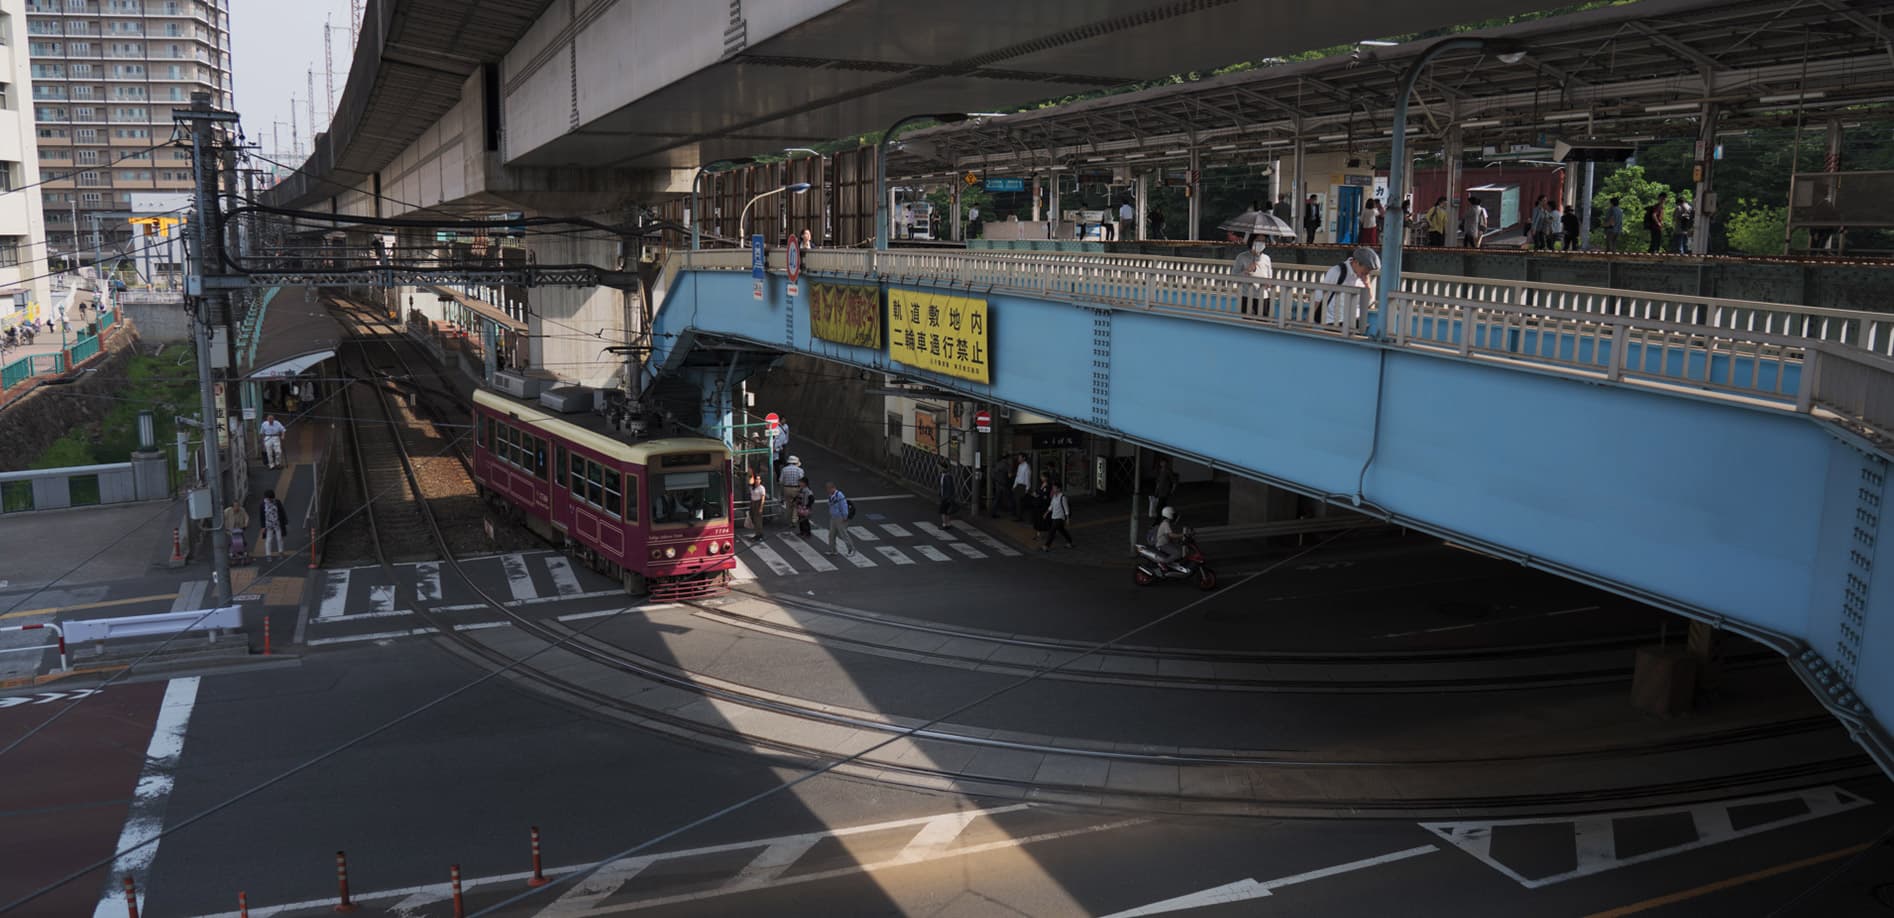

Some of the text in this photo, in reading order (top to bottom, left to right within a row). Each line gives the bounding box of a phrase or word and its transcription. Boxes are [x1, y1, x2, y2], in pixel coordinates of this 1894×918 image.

[892, 299, 983, 335] 軌道敷地内
[893, 328, 984, 365] 二輪車通行禁止
